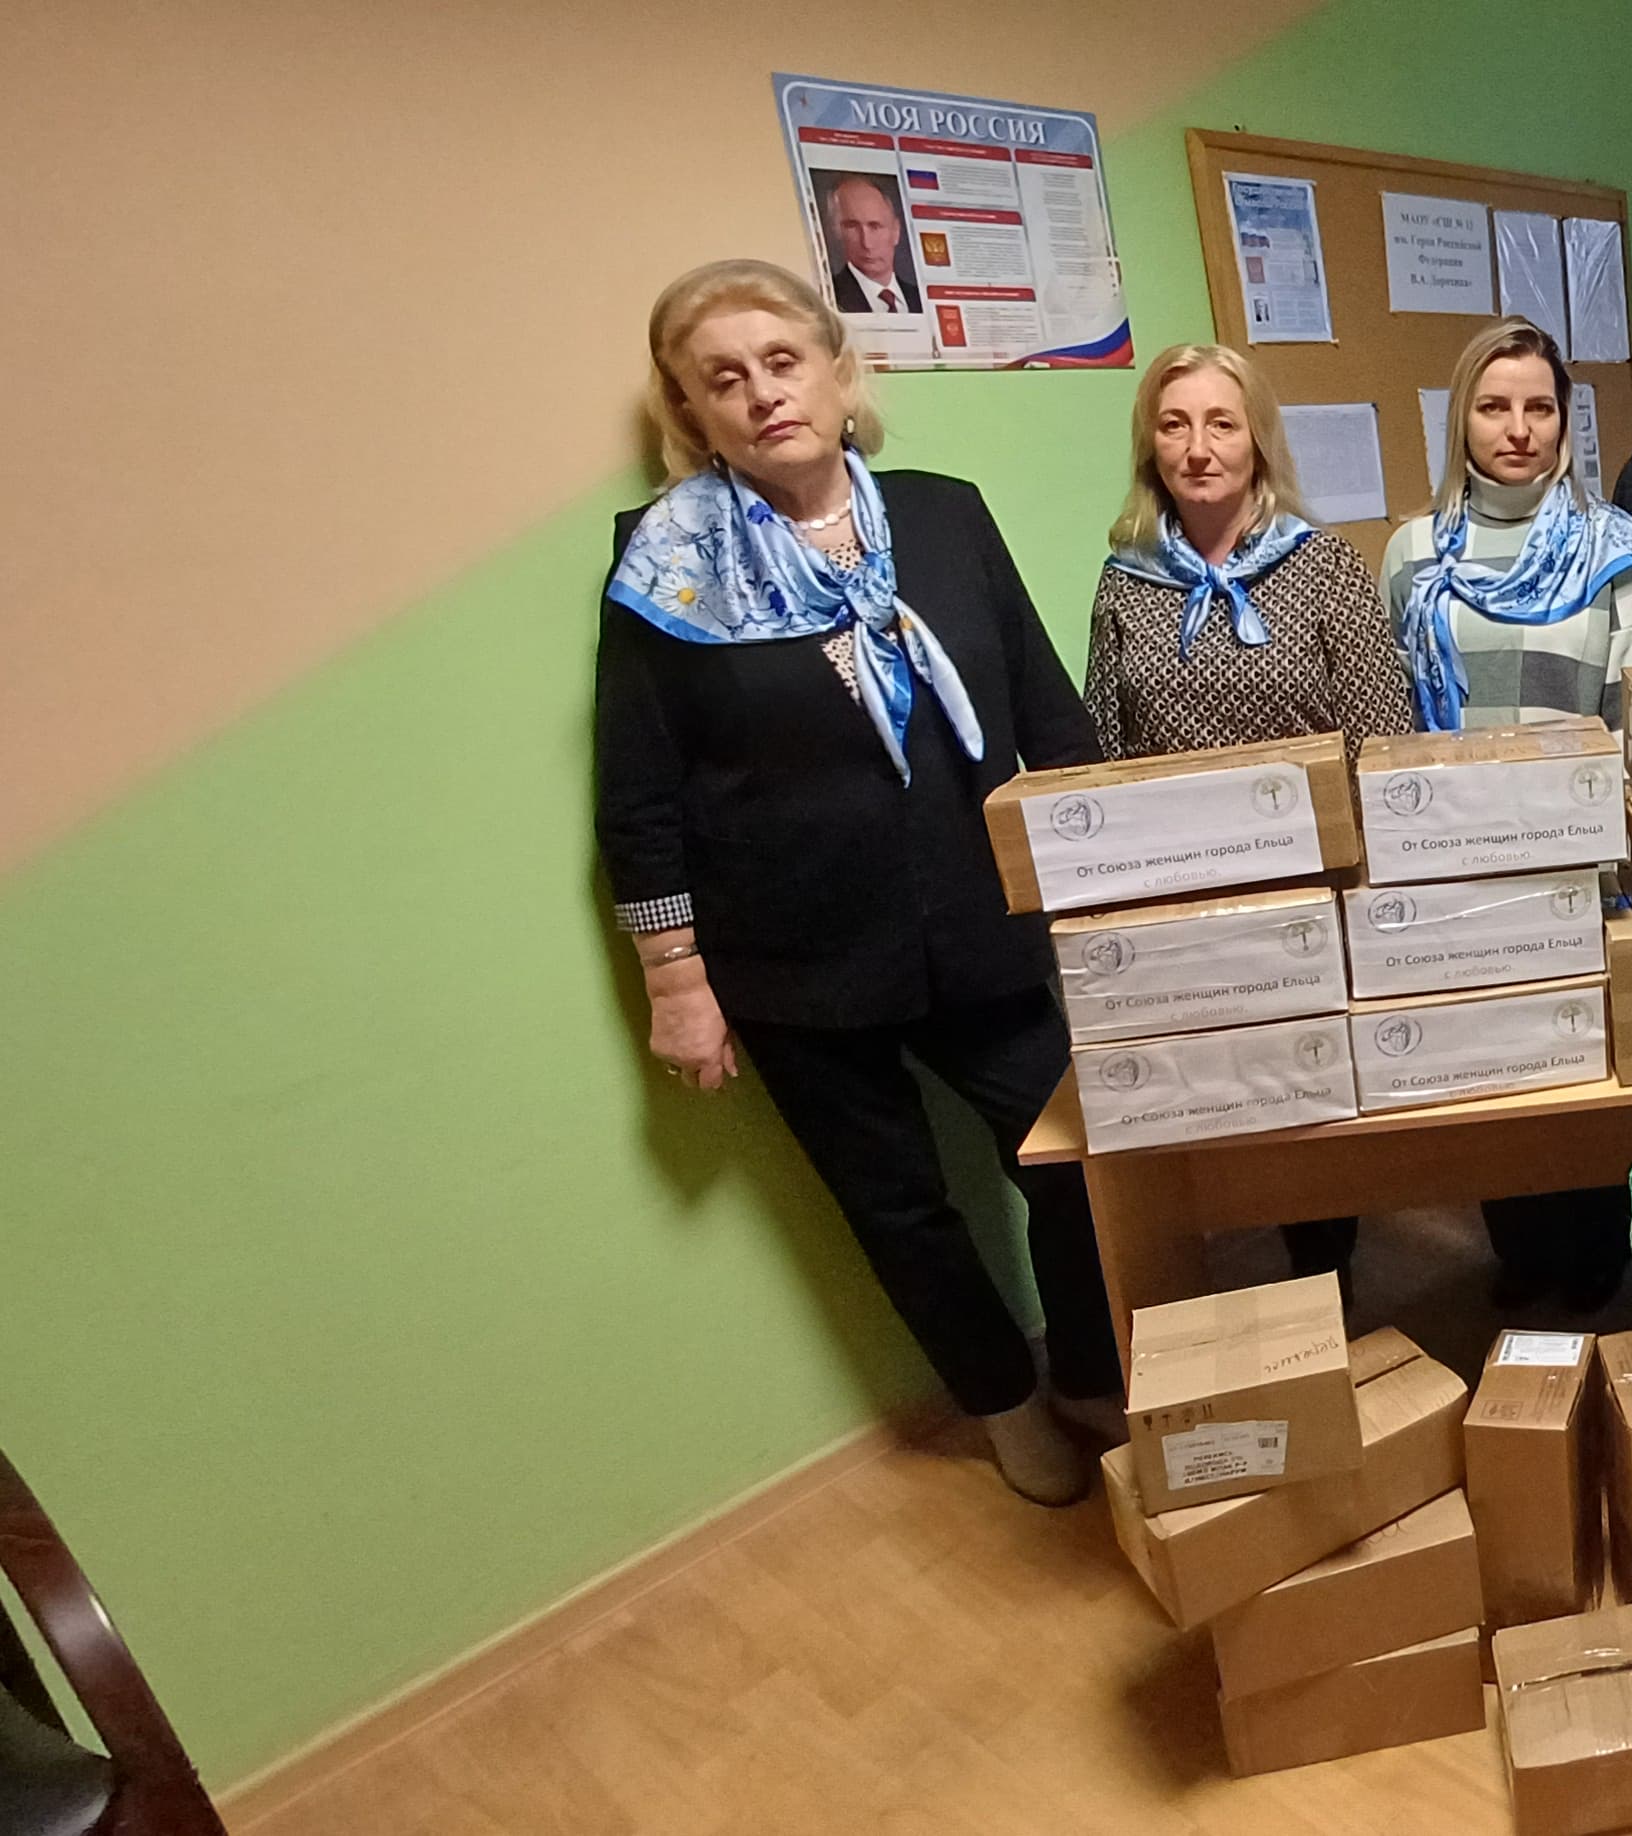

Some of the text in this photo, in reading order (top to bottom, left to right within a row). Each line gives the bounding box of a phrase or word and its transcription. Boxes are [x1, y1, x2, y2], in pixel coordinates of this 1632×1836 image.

[849, 99, 1047, 145] МОЯ РОССИЯ
[1076, 834, 1294, 878] От Союза женщин города Ельца
[1401, 824, 1604, 852] От Союза женщин города Ельца
[1386, 936, 1583, 967] От Союза женщин города Ельца
[1105, 974, 1321, 1010] От Союза женщин города Ельца
[1391, 1055, 1585, 1089] От Союза женщин города Ельца
[1121, 1115, 1139, 1125] От
[1142, 1109, 1184, 1123] Союза
[1188, 1101, 1243, 1116] женщин
[1294, 1087, 1332, 1101] Ельца
